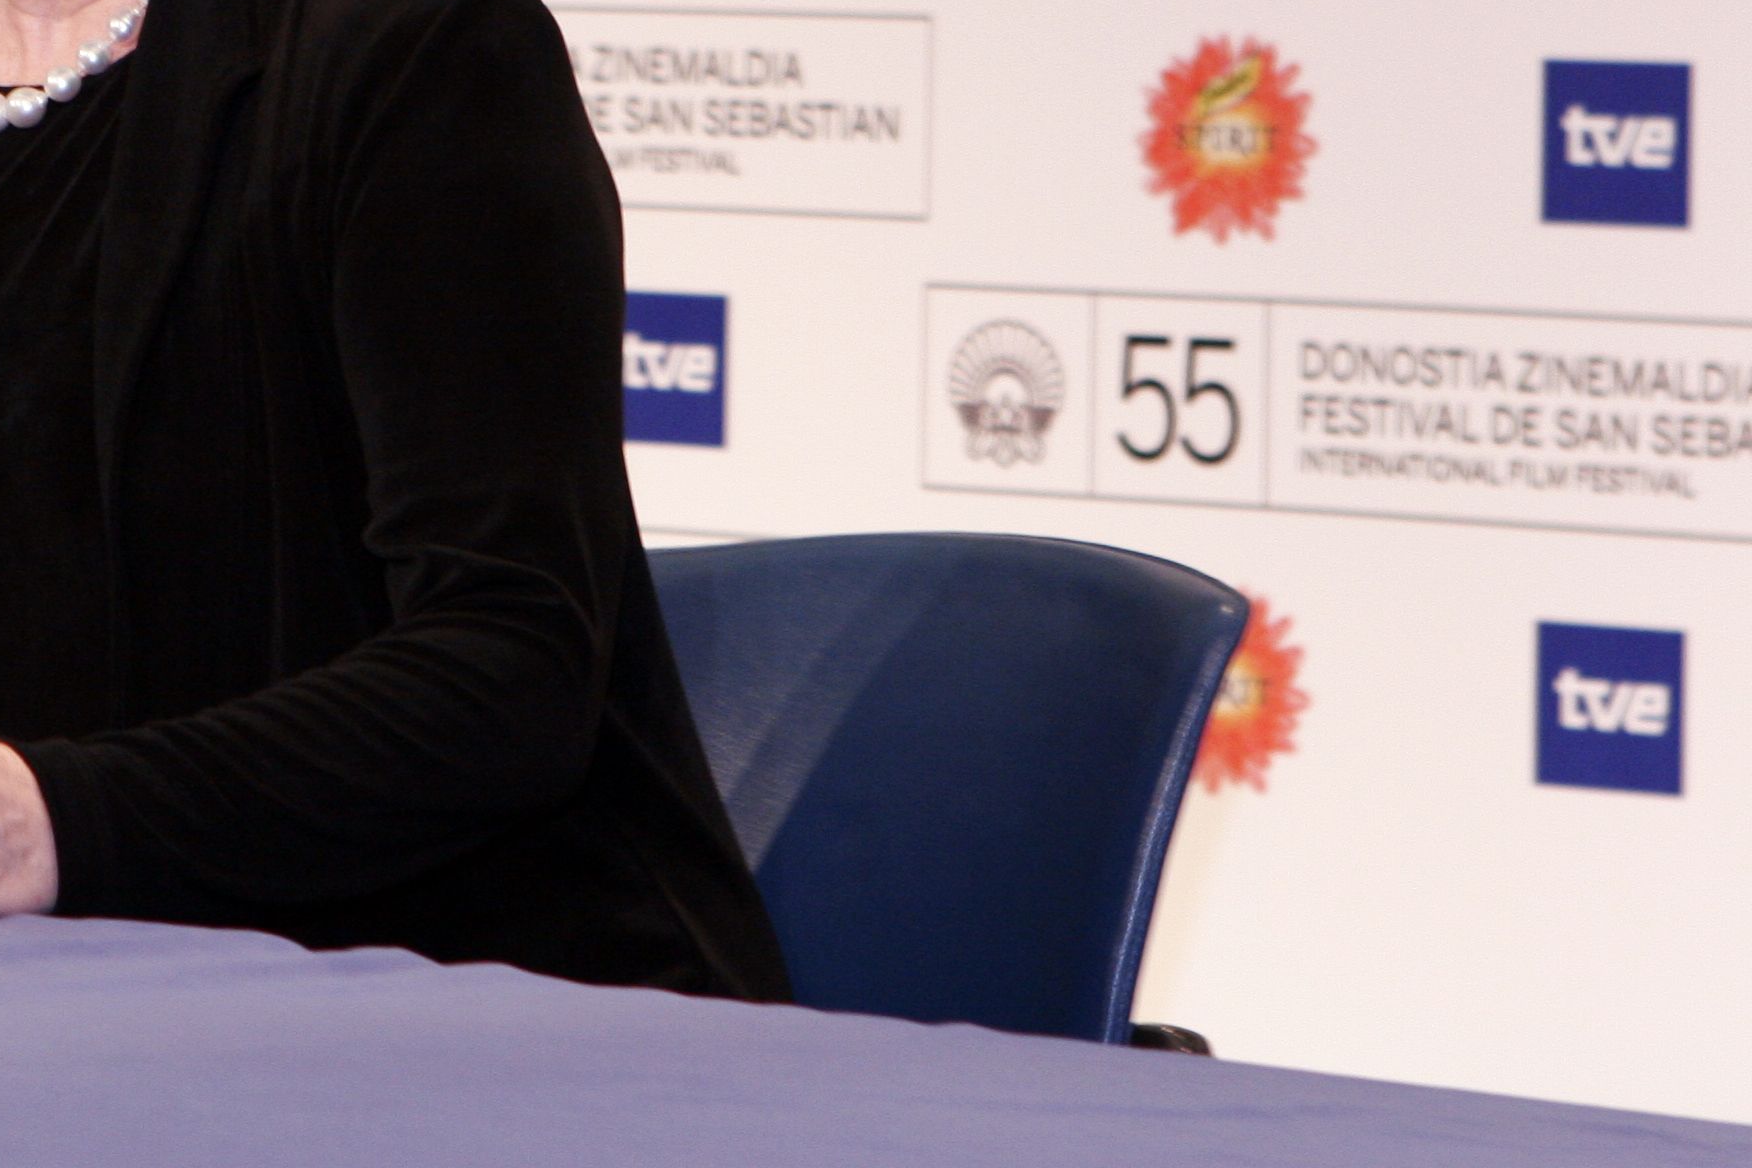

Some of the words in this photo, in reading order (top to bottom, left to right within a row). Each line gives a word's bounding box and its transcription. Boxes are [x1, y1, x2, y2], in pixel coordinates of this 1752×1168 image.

[591, 45, 803, 89] ZINEMALDIA
[621, 96, 694, 136] SAN
[703, 99, 901, 143] SEBASTIAN
[1561, 106, 1676, 169] tve
[624, 332, 716, 392] tve
[1302, 341, 1507, 392] DONOSTIA
[1516, 352, 1752, 404] ZINEMALDI
[1115, 334, 1244, 467] 55
[1301, 394, 1481, 444] FESTIVAL
[1488, 405, 1542, 448] DE
[1552, 408, 1640, 454] SAN
[1299, 447, 1503, 486] INTERNATIONAL
[1572, 463, 1697, 499] FESTIVAL
[1554, 669, 1670, 736] tve
